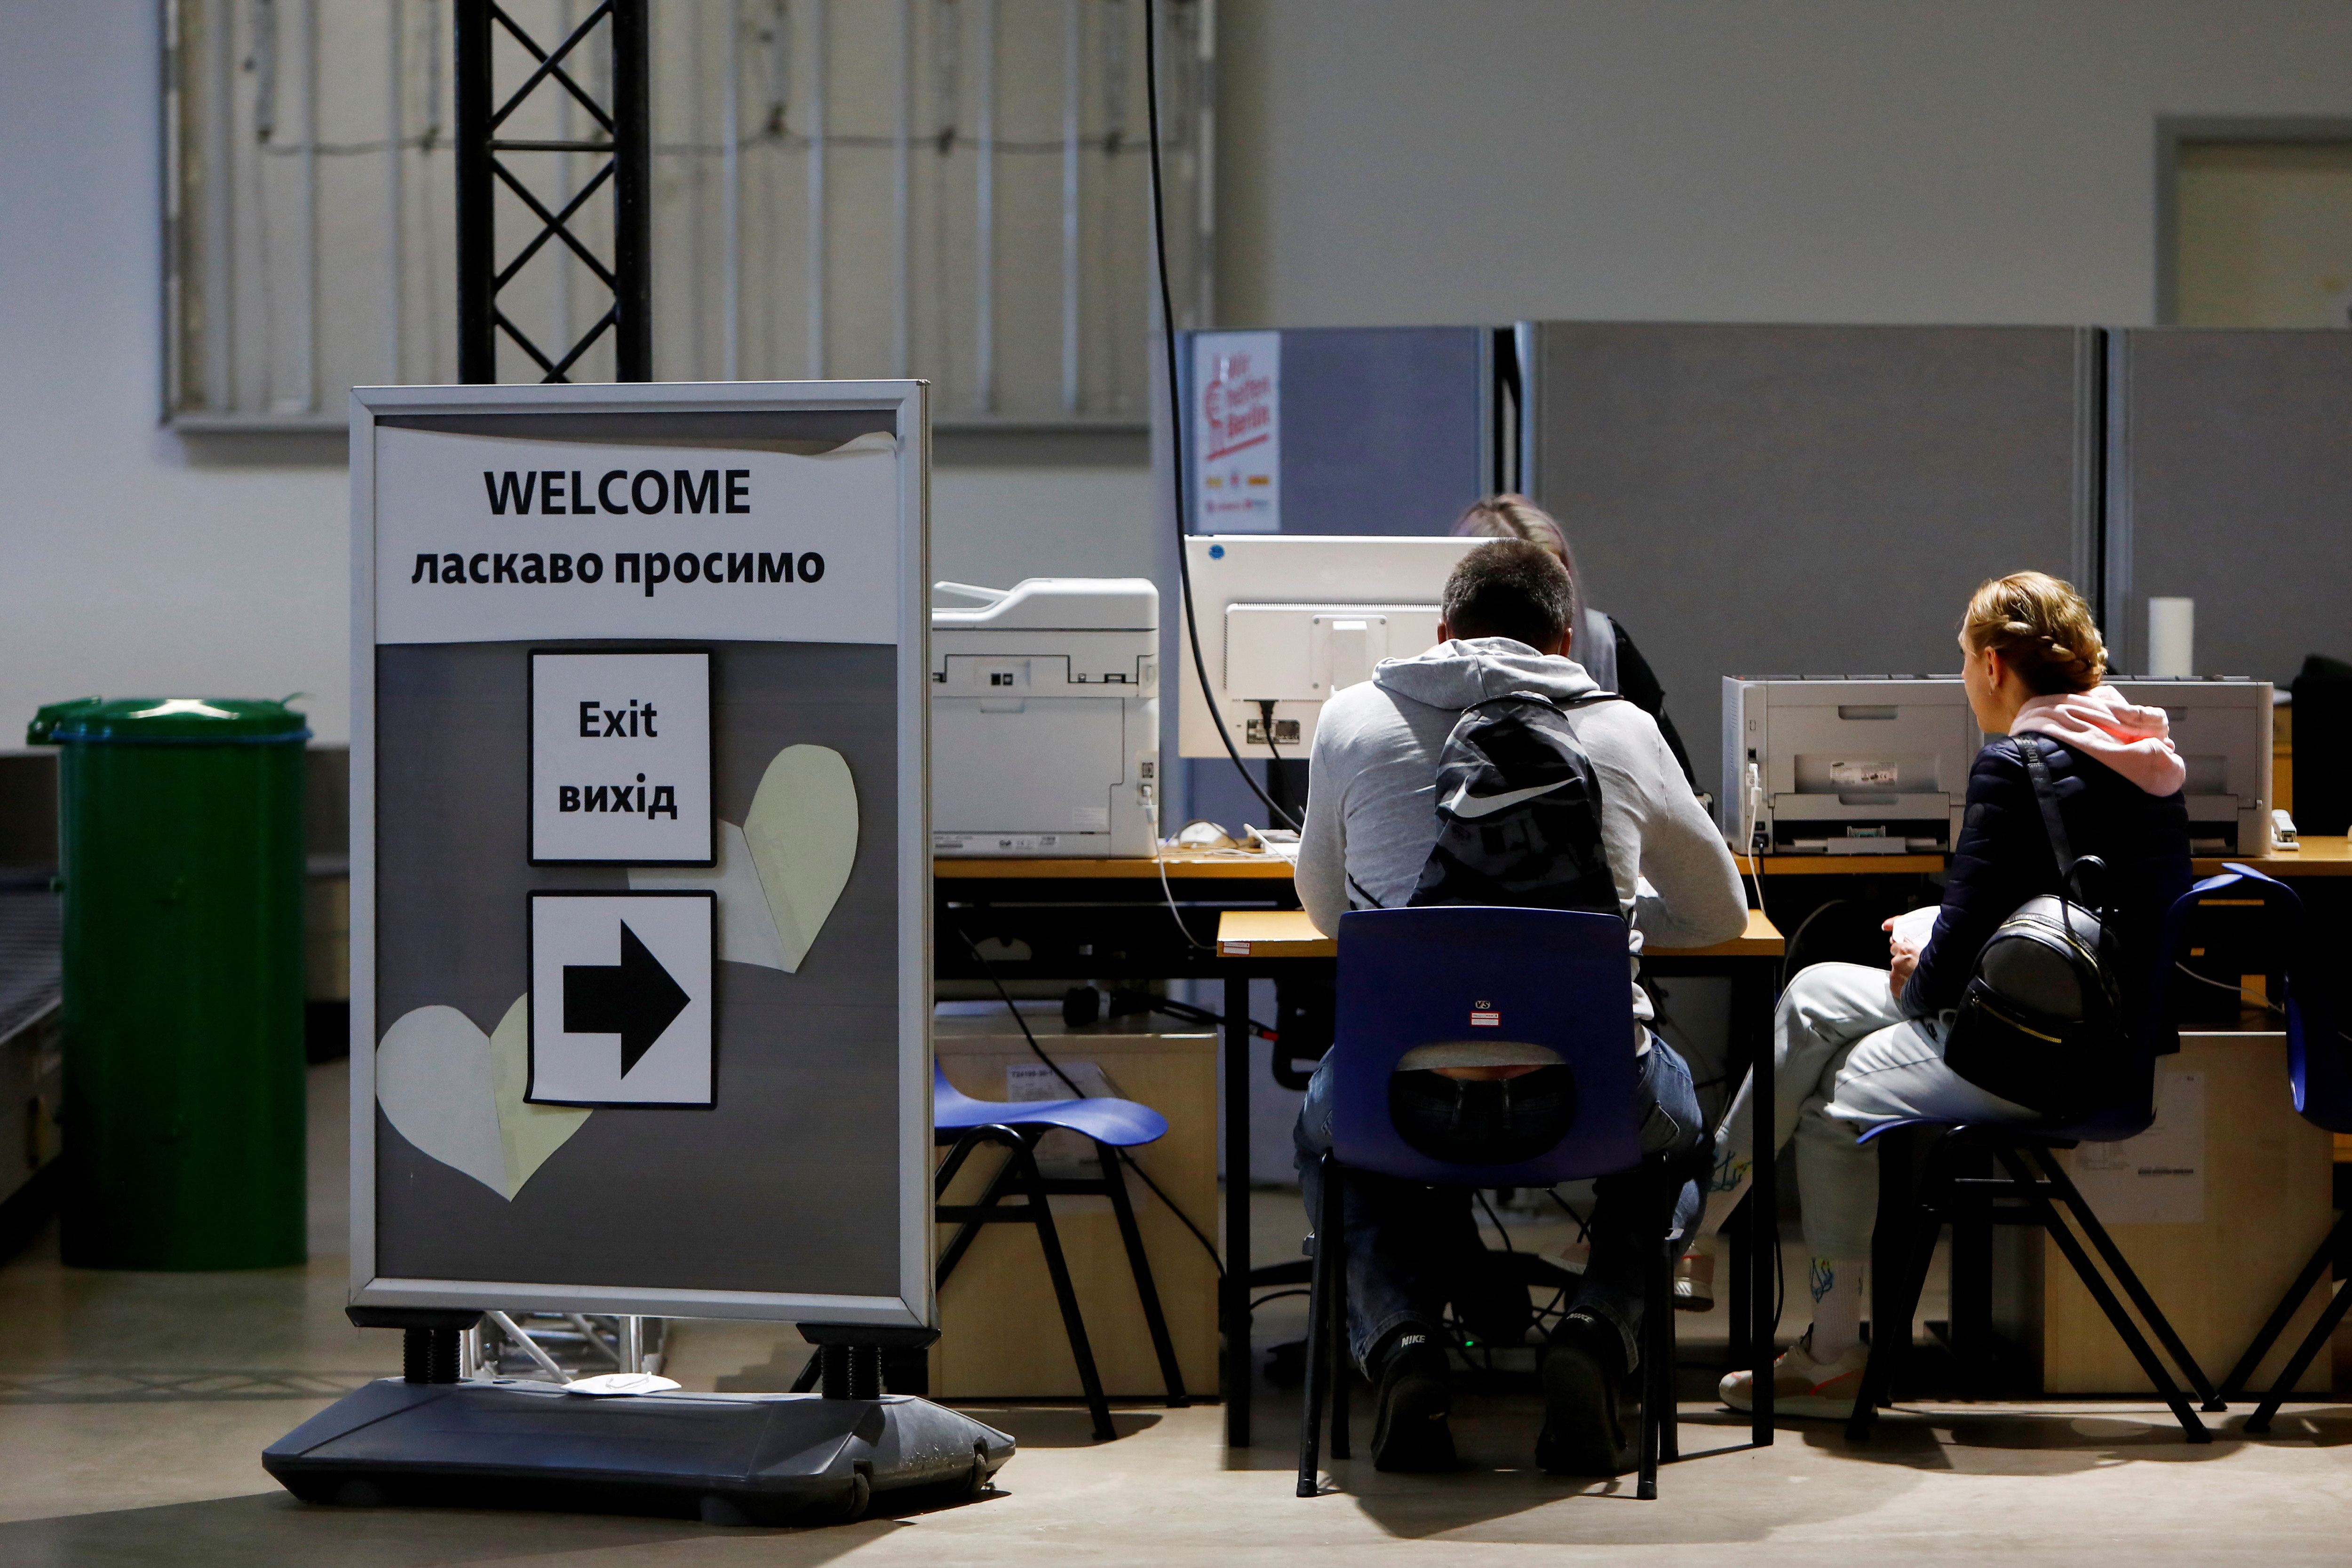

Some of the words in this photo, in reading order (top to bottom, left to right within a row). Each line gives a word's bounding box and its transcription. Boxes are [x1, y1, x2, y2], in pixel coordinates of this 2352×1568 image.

[484, 469, 750, 515] WELCOME
[411, 553, 603, 584] ласкаво
[615, 551, 825, 597] просимо
[580, 699, 658, 737] Exit
[559, 773, 677, 820] вихід
[1401, 1335, 1425, 1348] NIKE
